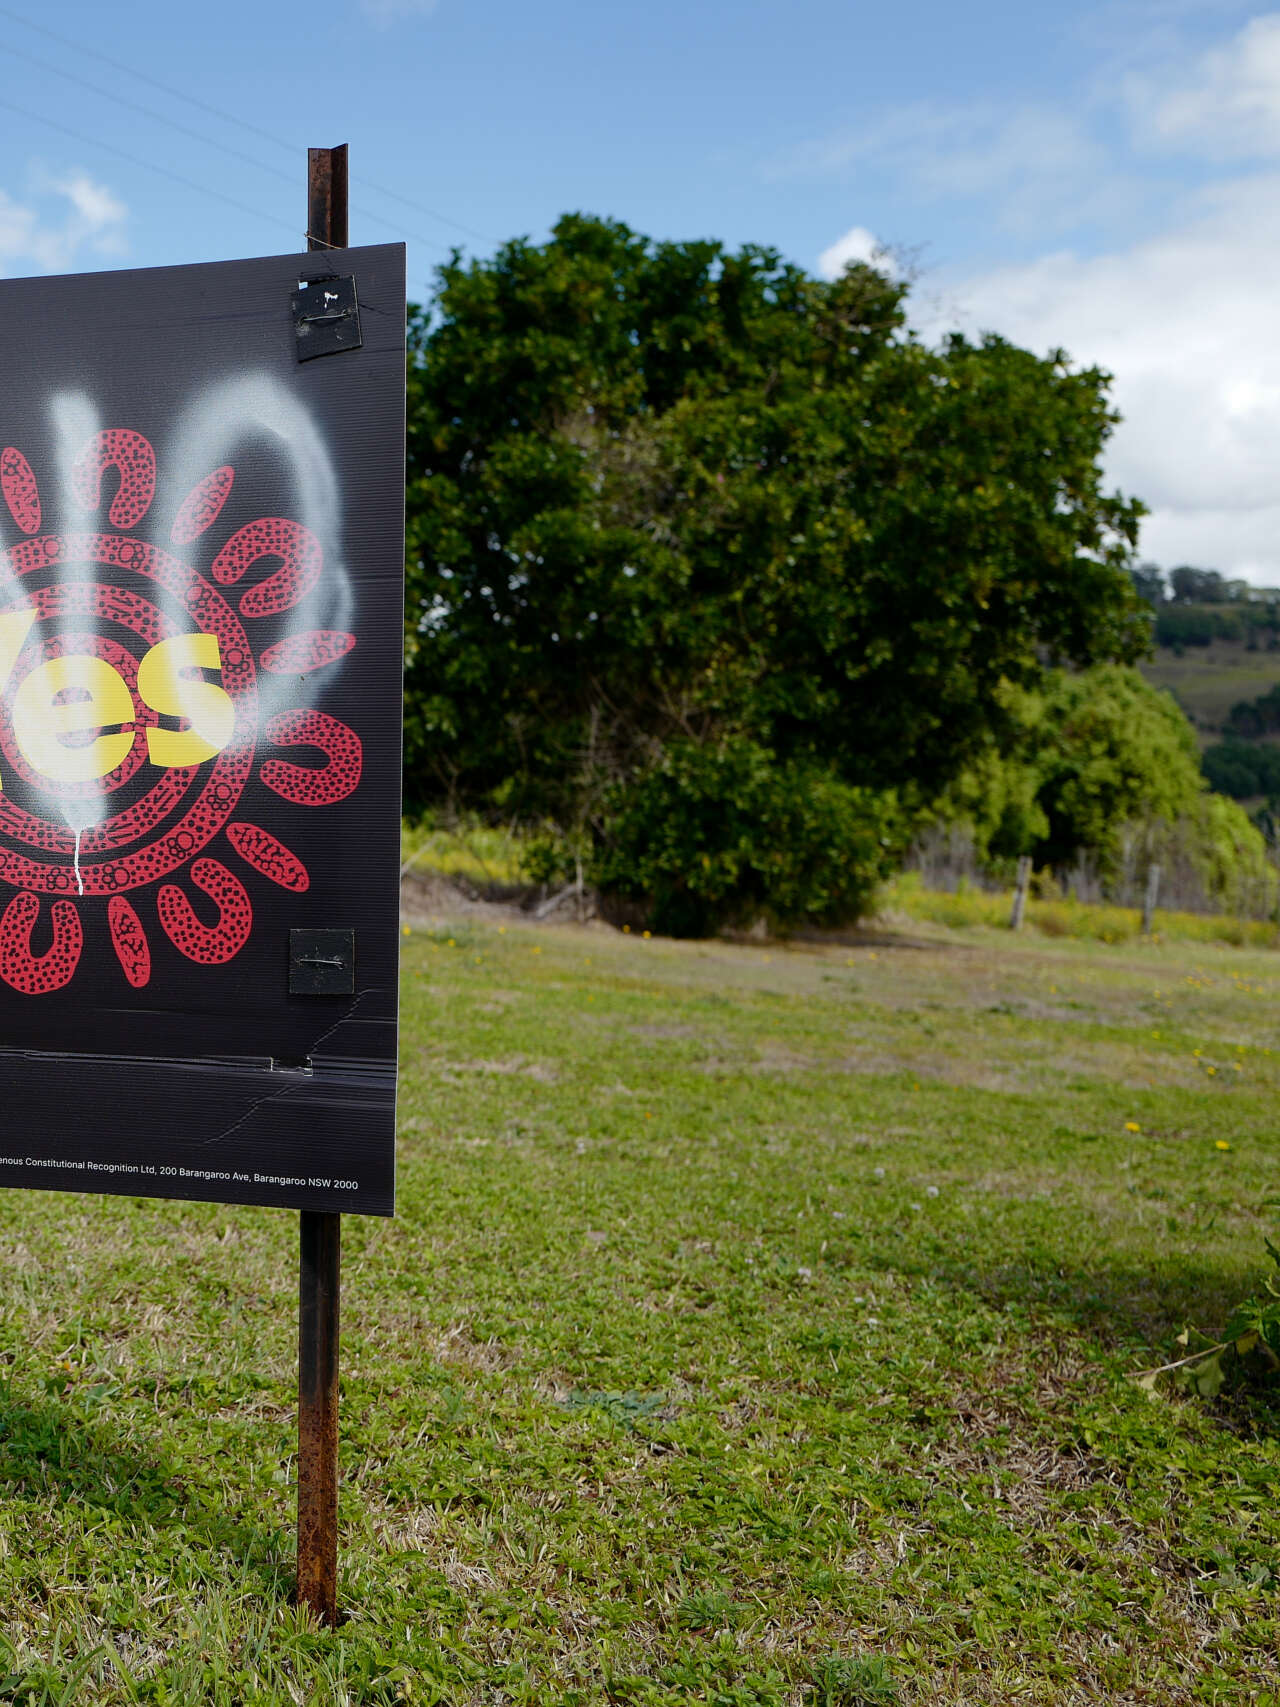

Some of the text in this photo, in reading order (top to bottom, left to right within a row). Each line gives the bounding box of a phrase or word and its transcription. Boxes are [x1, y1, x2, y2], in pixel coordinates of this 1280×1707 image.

[25, 1157, 86, 1169] Constitutional
[87, 1161, 139, 1173] Recognition
[140, 1165, 158, 1176] Ltd,
[159, 1166, 178, 1176] 200
[179, 1168, 231, 1180] Barangaroo
[232, 1171, 252, 1183] Ave,
[253, 1173, 307, 1186] Barangaroo
[308, 1178, 332, 1188] NSW
[333, 1179, 360, 1190] 2000
